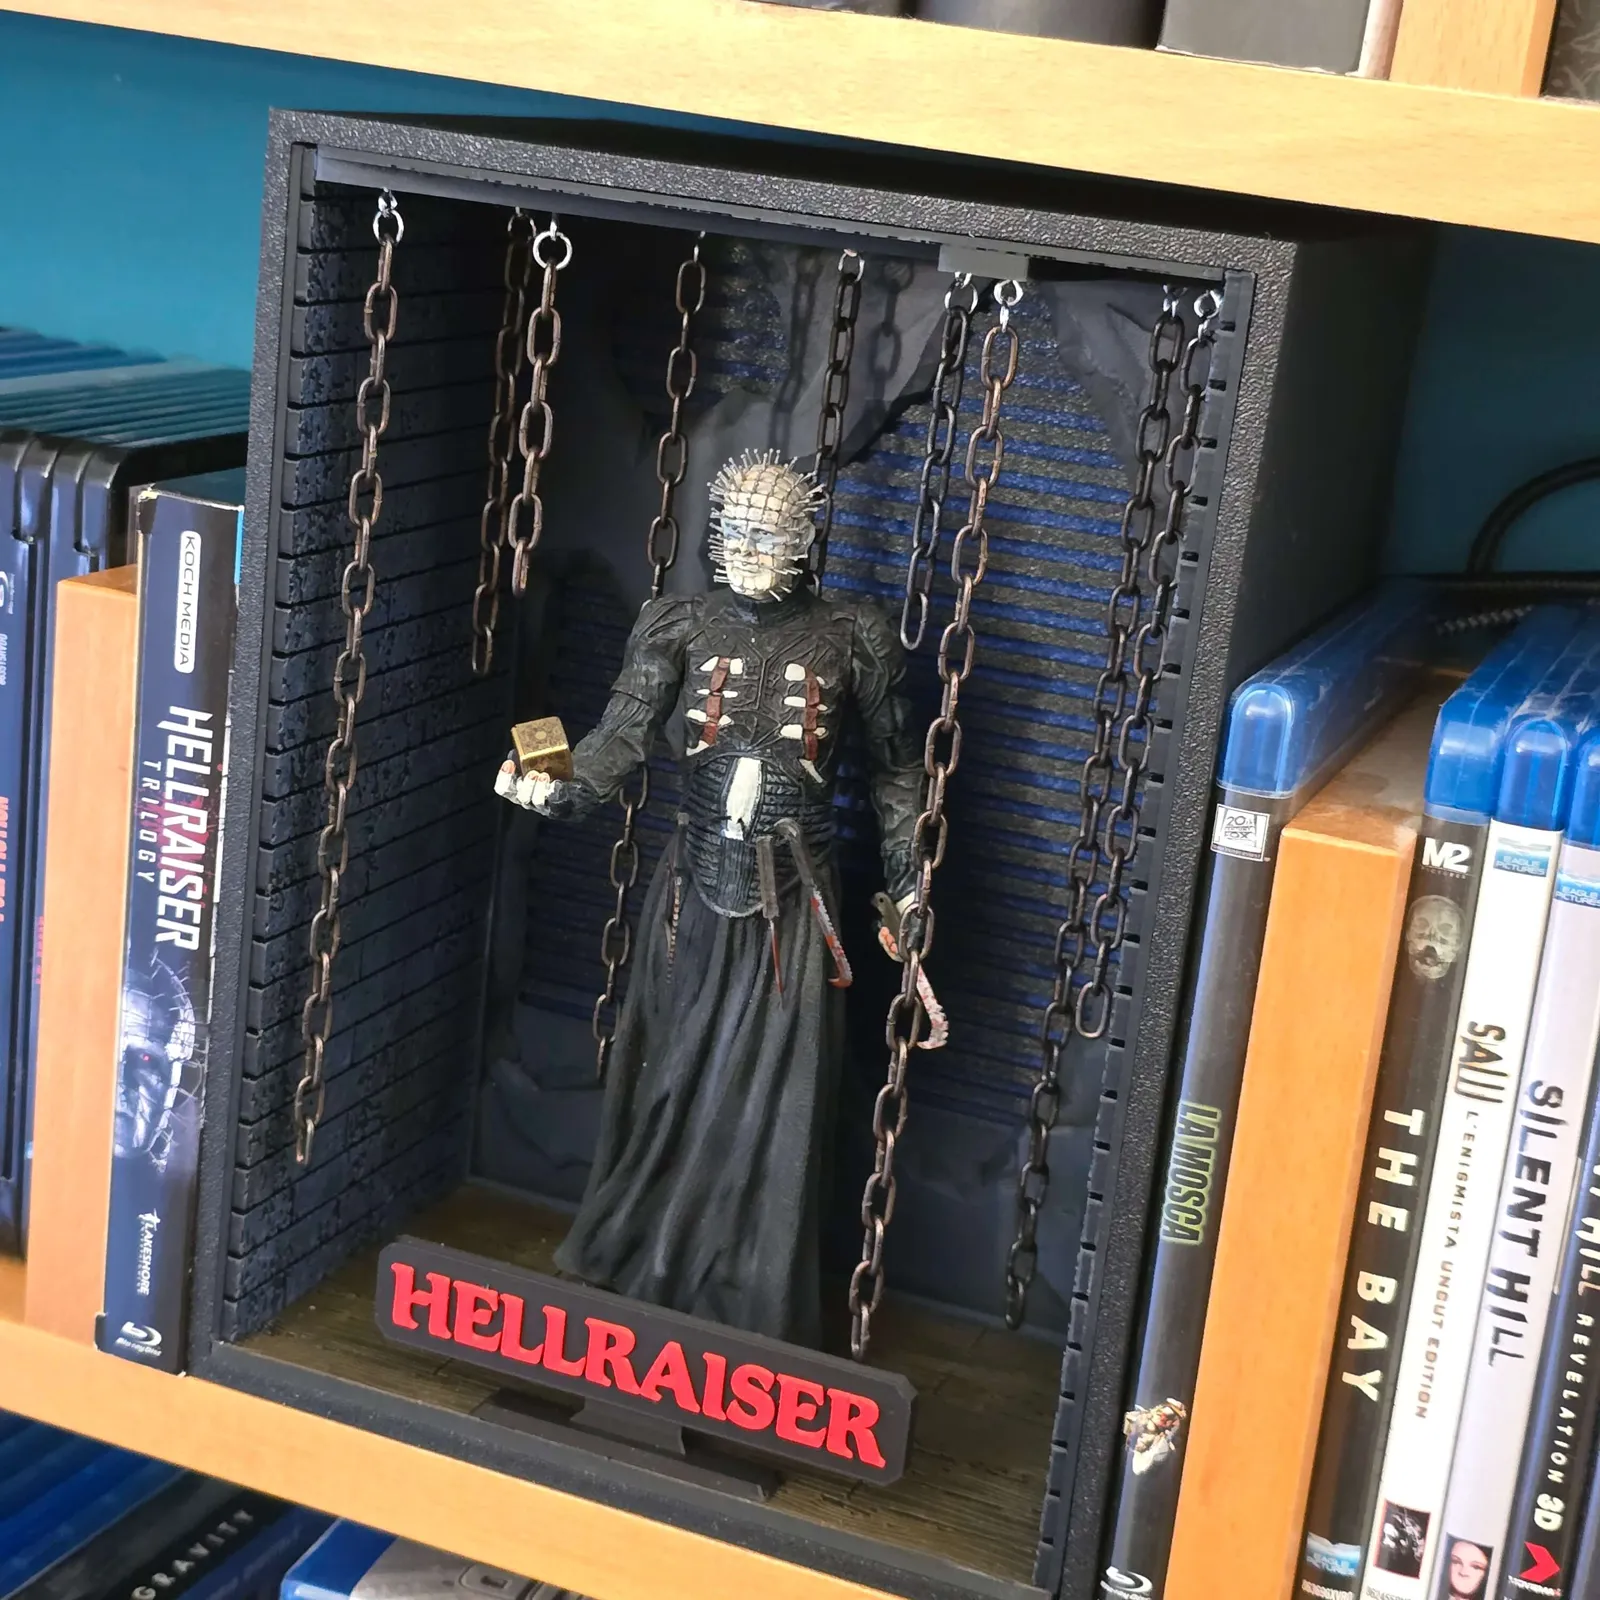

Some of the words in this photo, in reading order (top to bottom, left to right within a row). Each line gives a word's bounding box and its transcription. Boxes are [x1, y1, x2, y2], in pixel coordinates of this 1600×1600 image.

[180, 535, 197, 596] KOCH
[178, 602, 193, 667] MEDIA
[138, 761, 161, 883] TRILOGY
[155, 705, 213, 951] HELLRAISER
[1422, 838, 1472, 873] M2
[1504, 855, 1540, 868] EAGLE
[1495, 860, 1546, 876] PICTURES
[1562, 886, 1598, 900] EAGLE
[1175, 1102, 1222, 1141] LA
[1159, 1140, 1216, 1245] MOSCA
[1366, 1108, 1426, 1233] THE
[1444, 1110, 1479, 1249] L'ENIGMISTA
[1498, 1079, 1568, 1259] SILENT
[140, 1222, 155, 1296] LAKESHORE
[1431, 1260, 1454, 1329] UNCUT
[1340, 1269, 1400, 1403] BAY
[1484, 1266, 1532, 1367] HILL
[390, 1263, 887, 1469] HELLRAISER
[1414, 1337, 1440, 1419] EDITION
[1547, 1312, 1595, 1484] REVELATION
[131, 1509, 253, 1600] GRAVITY
[1533, 1492, 1565, 1532] 3D
